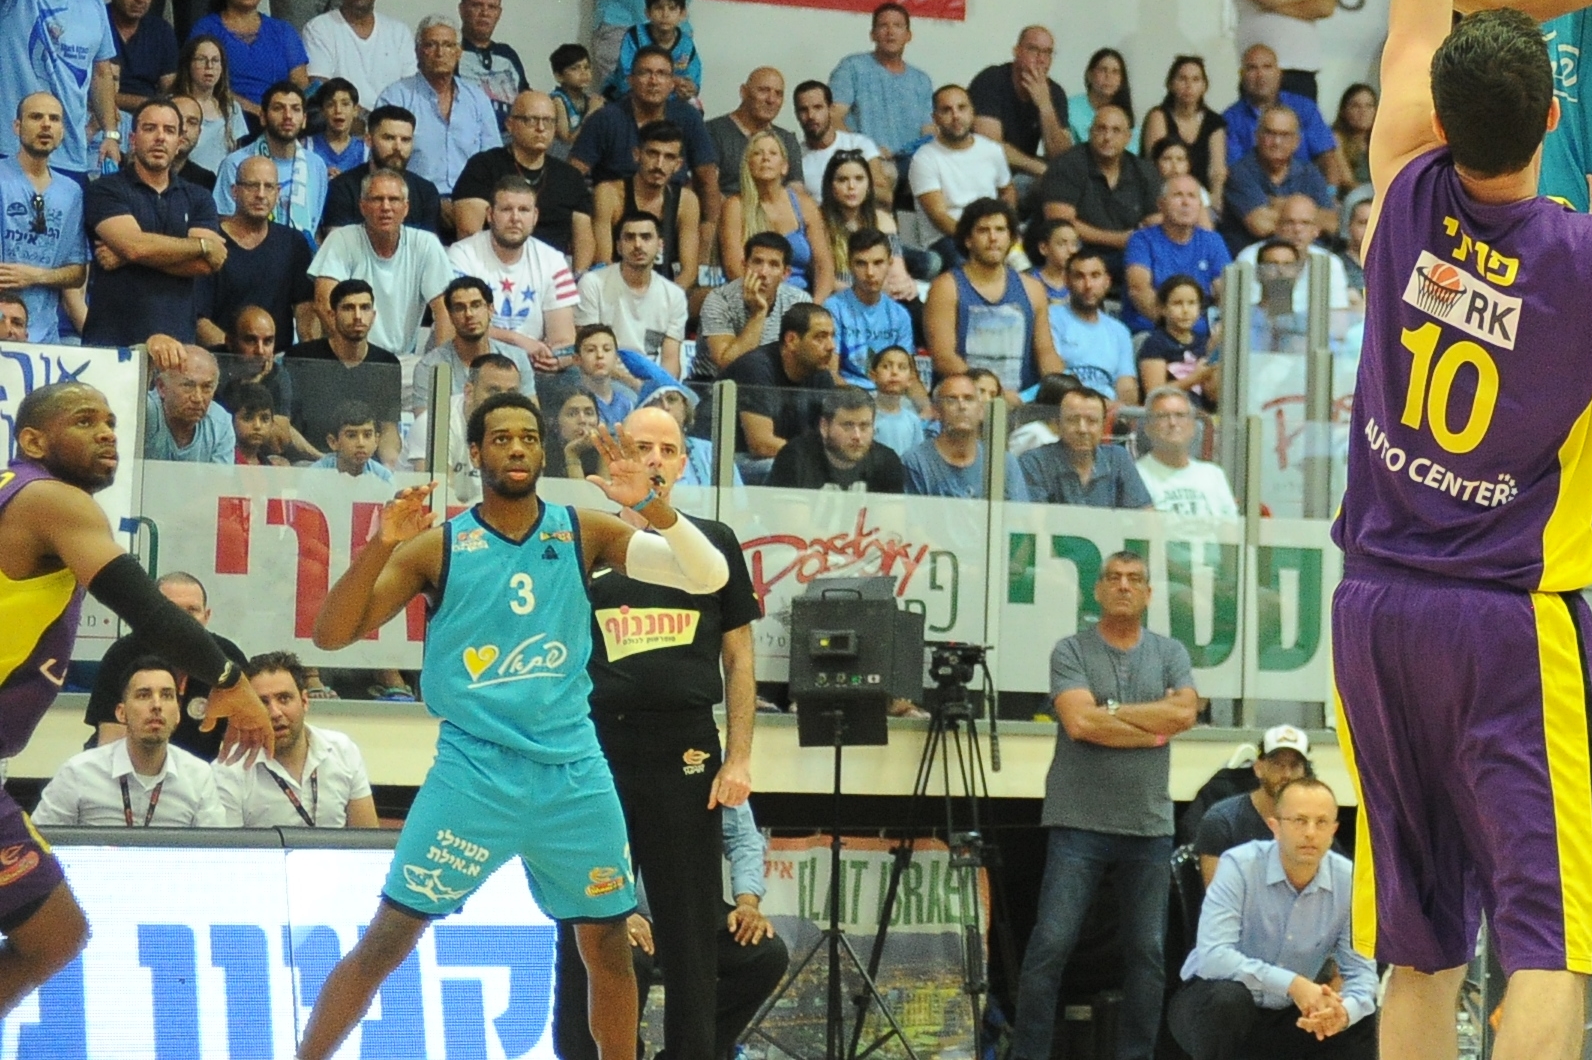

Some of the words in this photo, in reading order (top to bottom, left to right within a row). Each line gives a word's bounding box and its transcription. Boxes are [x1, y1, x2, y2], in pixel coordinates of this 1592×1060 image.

[1464, 290, 1516, 342] RK
[1401, 321, 1499, 454] 10
[1364, 417, 1406, 472] AUTO
[1408, 457, 1512, 507] CENTER
[509, 572, 536, 616] 3
